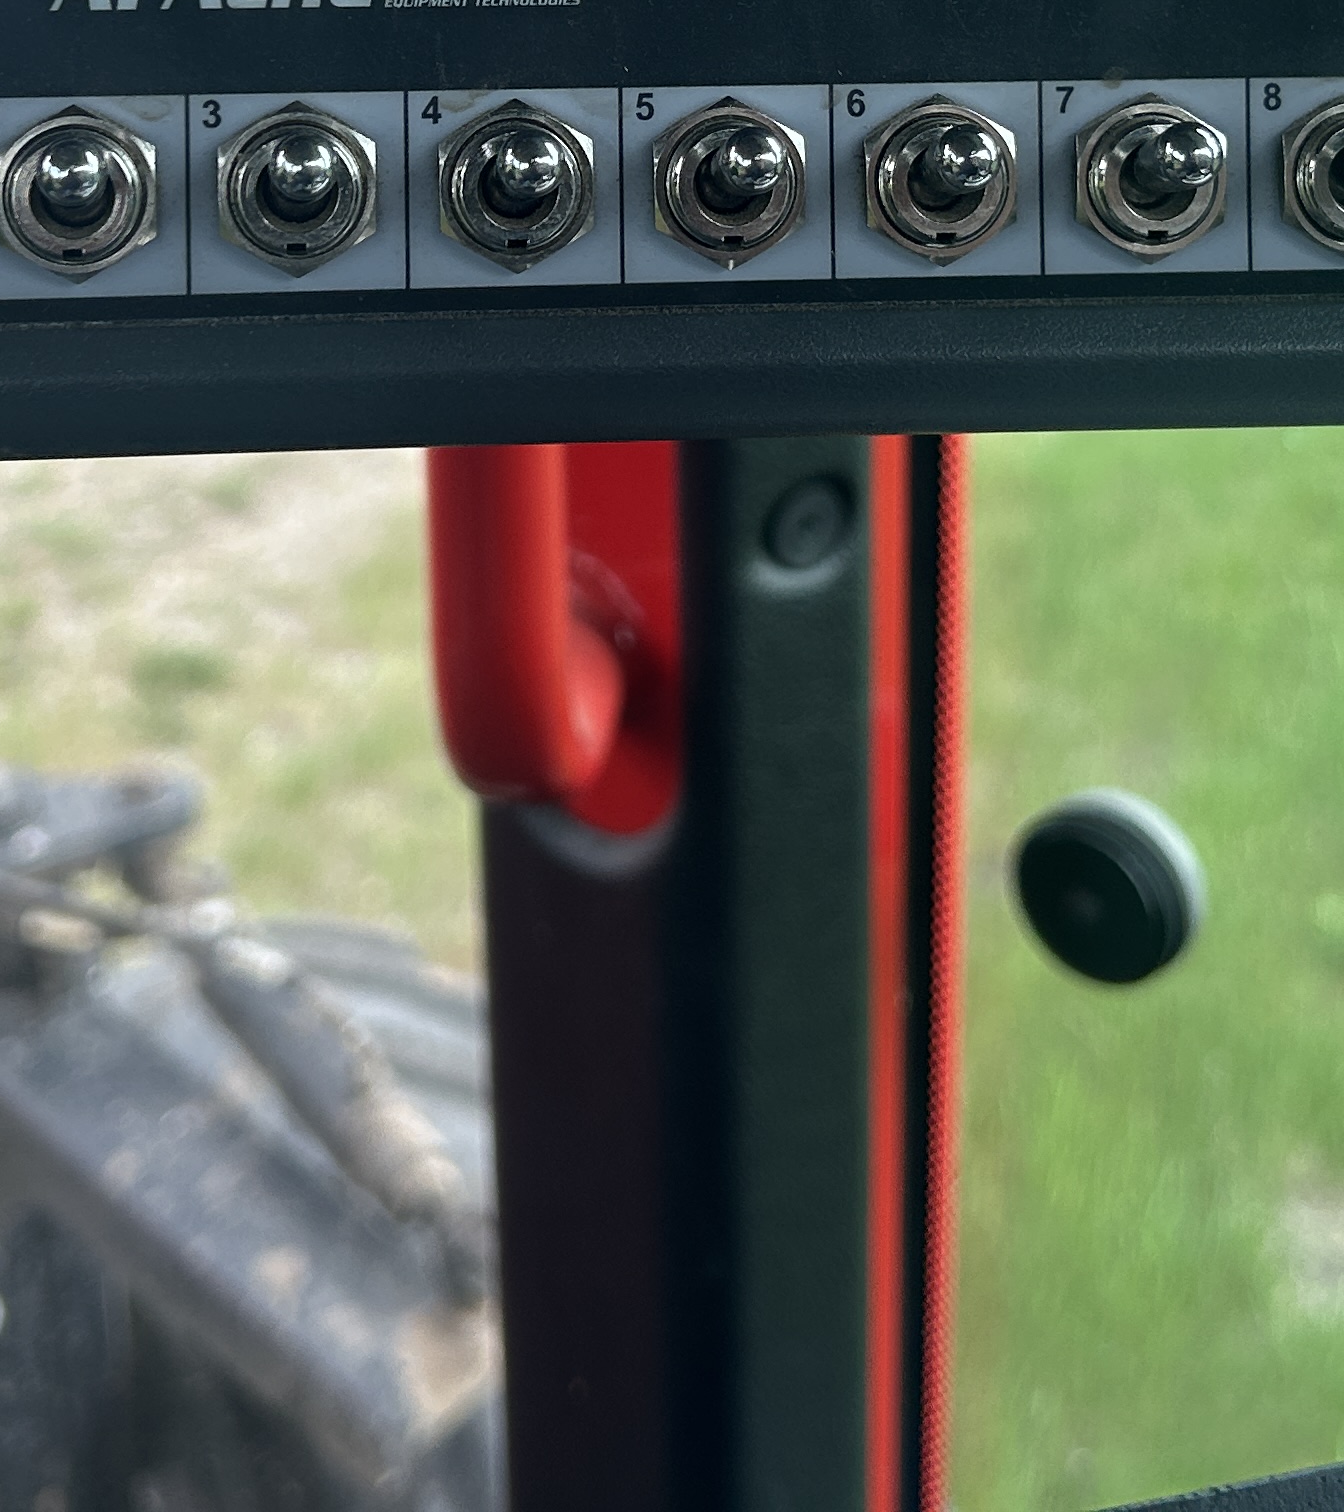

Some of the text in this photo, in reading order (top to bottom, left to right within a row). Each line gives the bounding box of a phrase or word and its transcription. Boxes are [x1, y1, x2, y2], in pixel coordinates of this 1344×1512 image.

[635, 93, 655, 121] 5
[846, 89, 866, 117] 6
[1056, 86, 1076, 114] 7
[1262, 82, 1282, 111] 8
[202, 100, 223, 128] 3
[420, 97, 442, 125] 4
